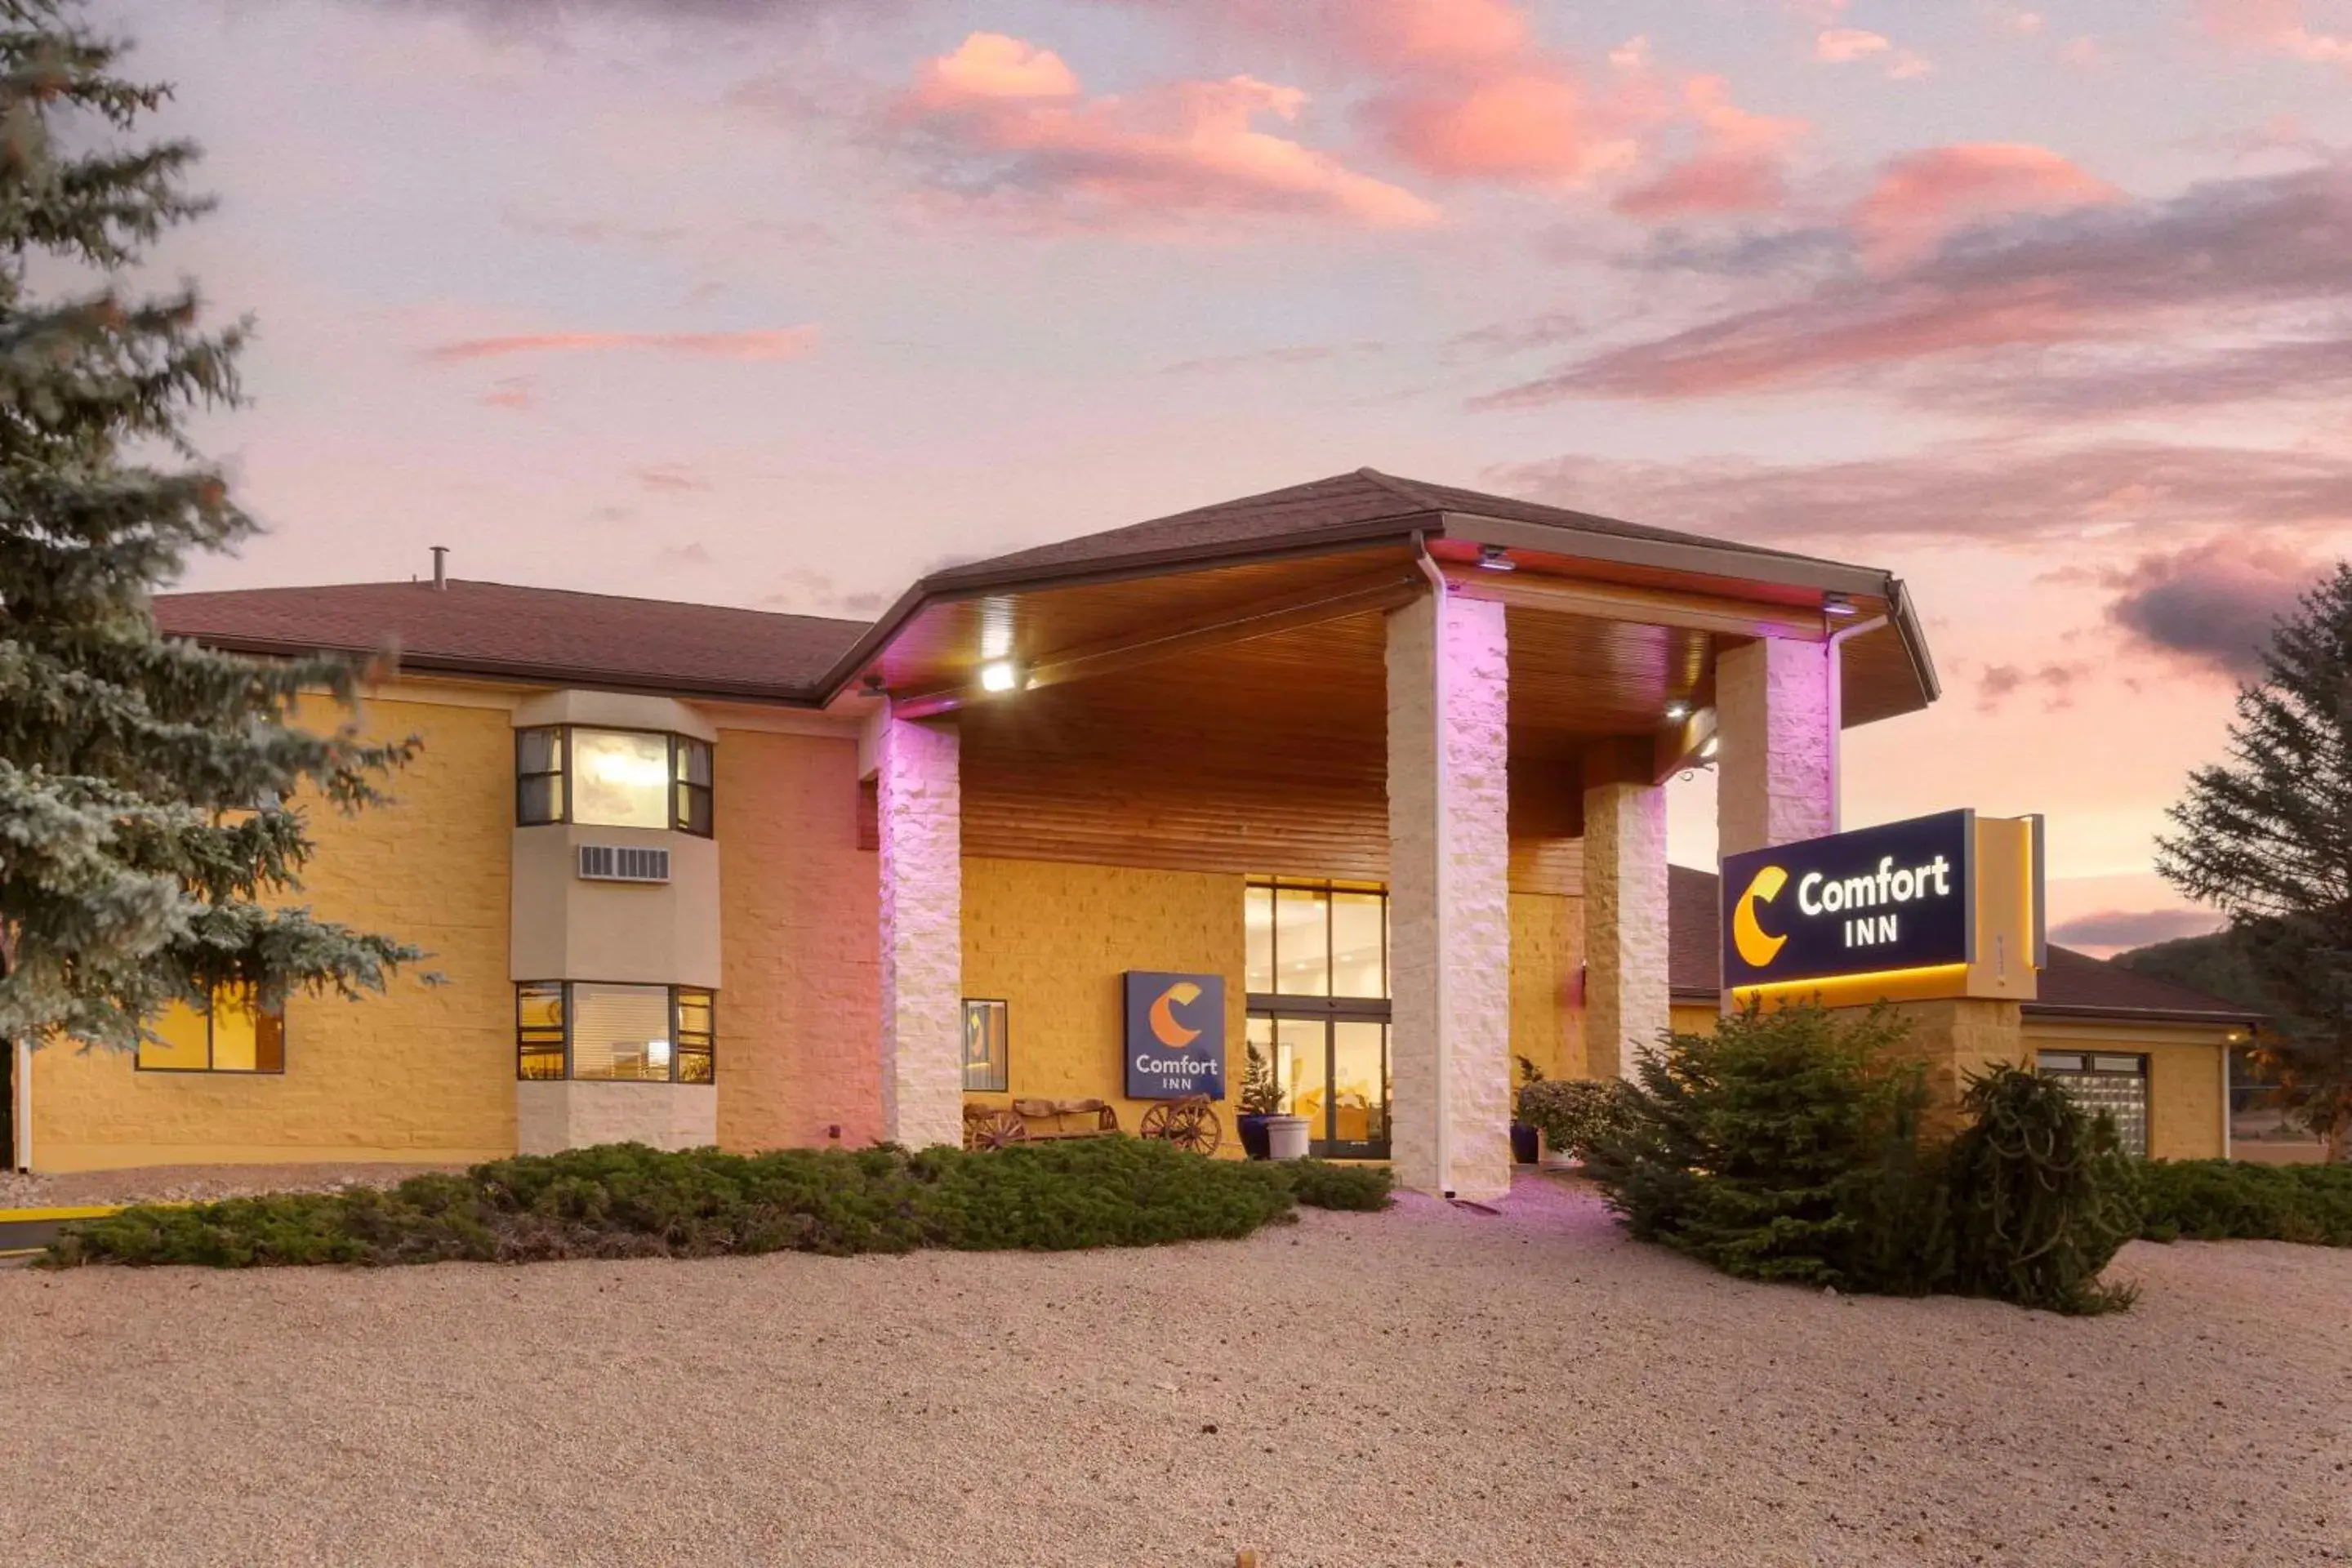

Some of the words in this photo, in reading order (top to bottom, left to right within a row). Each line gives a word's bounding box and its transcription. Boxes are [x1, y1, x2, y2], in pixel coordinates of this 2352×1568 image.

[1797, 854, 1950, 916] Comfort
[1844, 914, 1898, 947] INN
[1136, 1054, 1218, 1075] Comfort
[1163, 1077, 1192, 1090] INN
